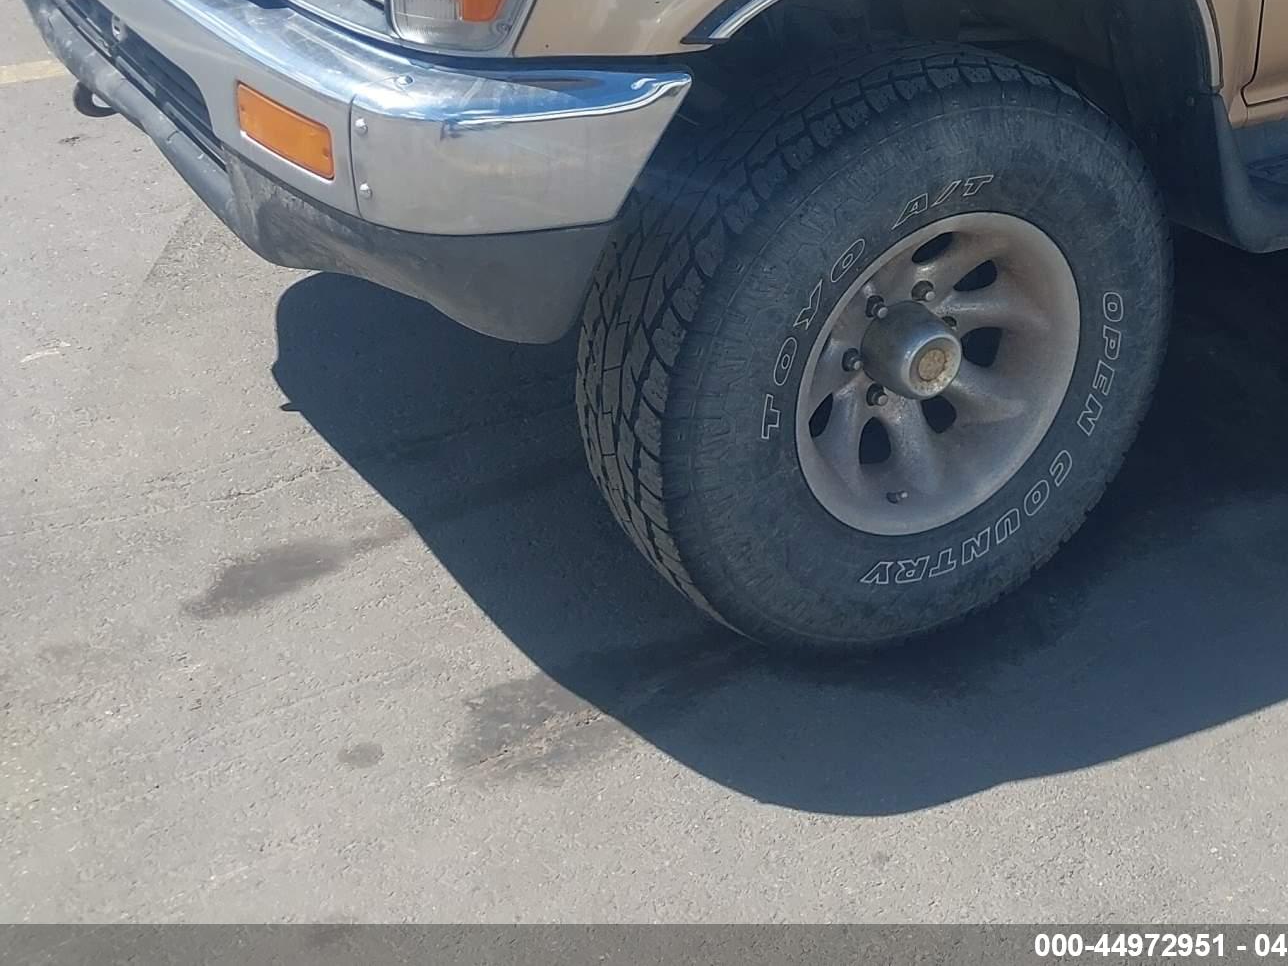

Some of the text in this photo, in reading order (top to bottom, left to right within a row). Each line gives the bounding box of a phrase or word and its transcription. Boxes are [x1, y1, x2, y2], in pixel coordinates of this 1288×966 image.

[761, 174, 994, 439] TOYO A/T
[859, 292, 1125, 584] OPEN COUNTRY
